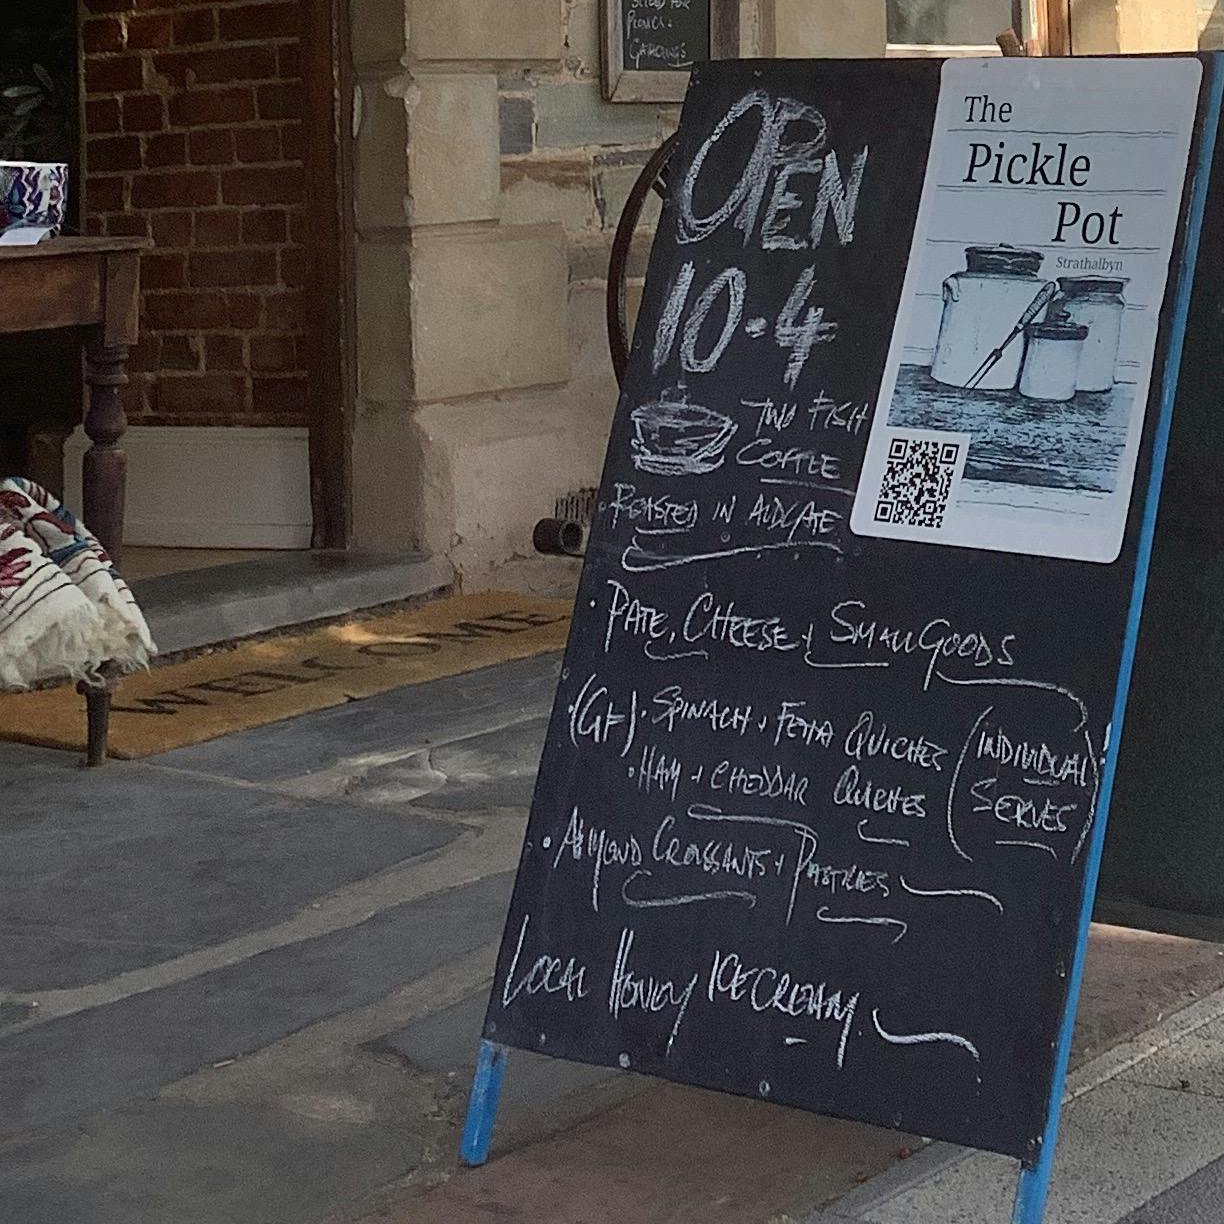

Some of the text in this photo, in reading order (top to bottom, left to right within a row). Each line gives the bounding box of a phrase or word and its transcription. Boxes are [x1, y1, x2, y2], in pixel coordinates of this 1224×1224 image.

[965, 95, 1013, 124] The
[675, 89, 870, 250] OPEN
[962, 142, 1091, 187] Pickle
[1051, 200, 1123, 246] Pot
[1056, 256, 1123, 273] Strathalbyn
[740, 389, 869, 436] TWO FISH
[736, 438, 841, 480] COFFEE
[611, 482, 698, 529] ROASTED
[712, 495, 736, 524] IN
[684, 593, 800, 650] CHEESE
[652, 686, 752, 736] SPINACH
[845, 711, 949, 772] QUICHES
[638, 745, 681, 802] HAM
[711, 760, 808, 805] CHEDDAR
[834, 765, 926, 818] QUICHES
[553, 806, 643, 912] ALMOND
[786, 826, 889, 926] PASTRIES
[502, 914, 589, 1009] LOCAL
[609, 928, 698, 1057] HONEY
